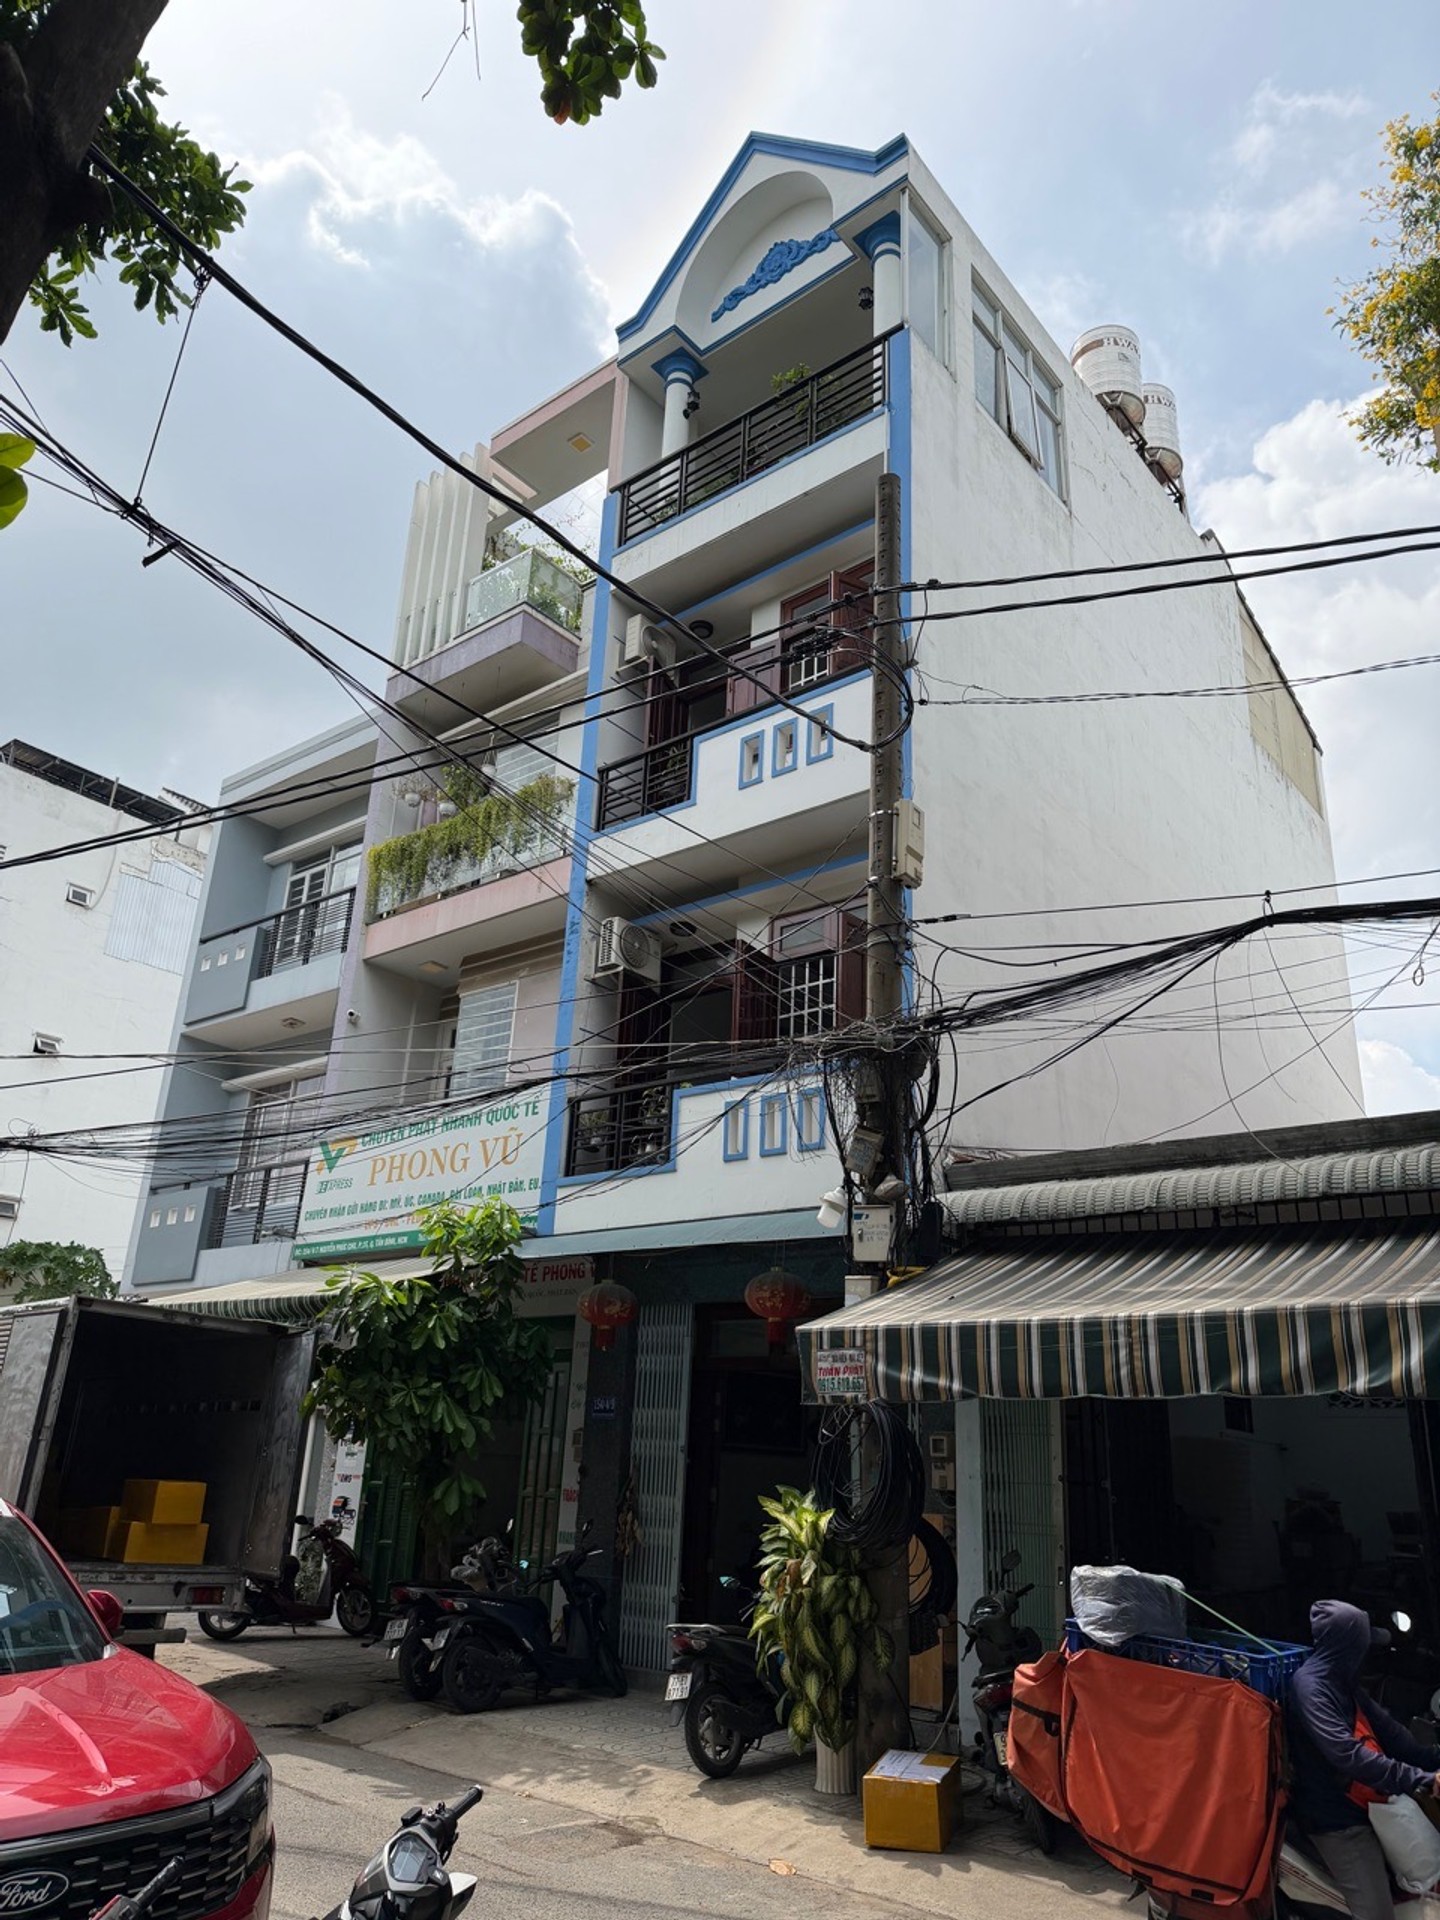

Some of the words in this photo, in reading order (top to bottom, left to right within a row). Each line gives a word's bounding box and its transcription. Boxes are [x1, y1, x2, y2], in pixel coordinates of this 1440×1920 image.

[367, 1142, 470, 1186] PHONG
[480, 1127, 523, 1169] VŨ
[542, 1262, 586, 1282] PHONG
[0, 1877, 52, 1909] Ford
